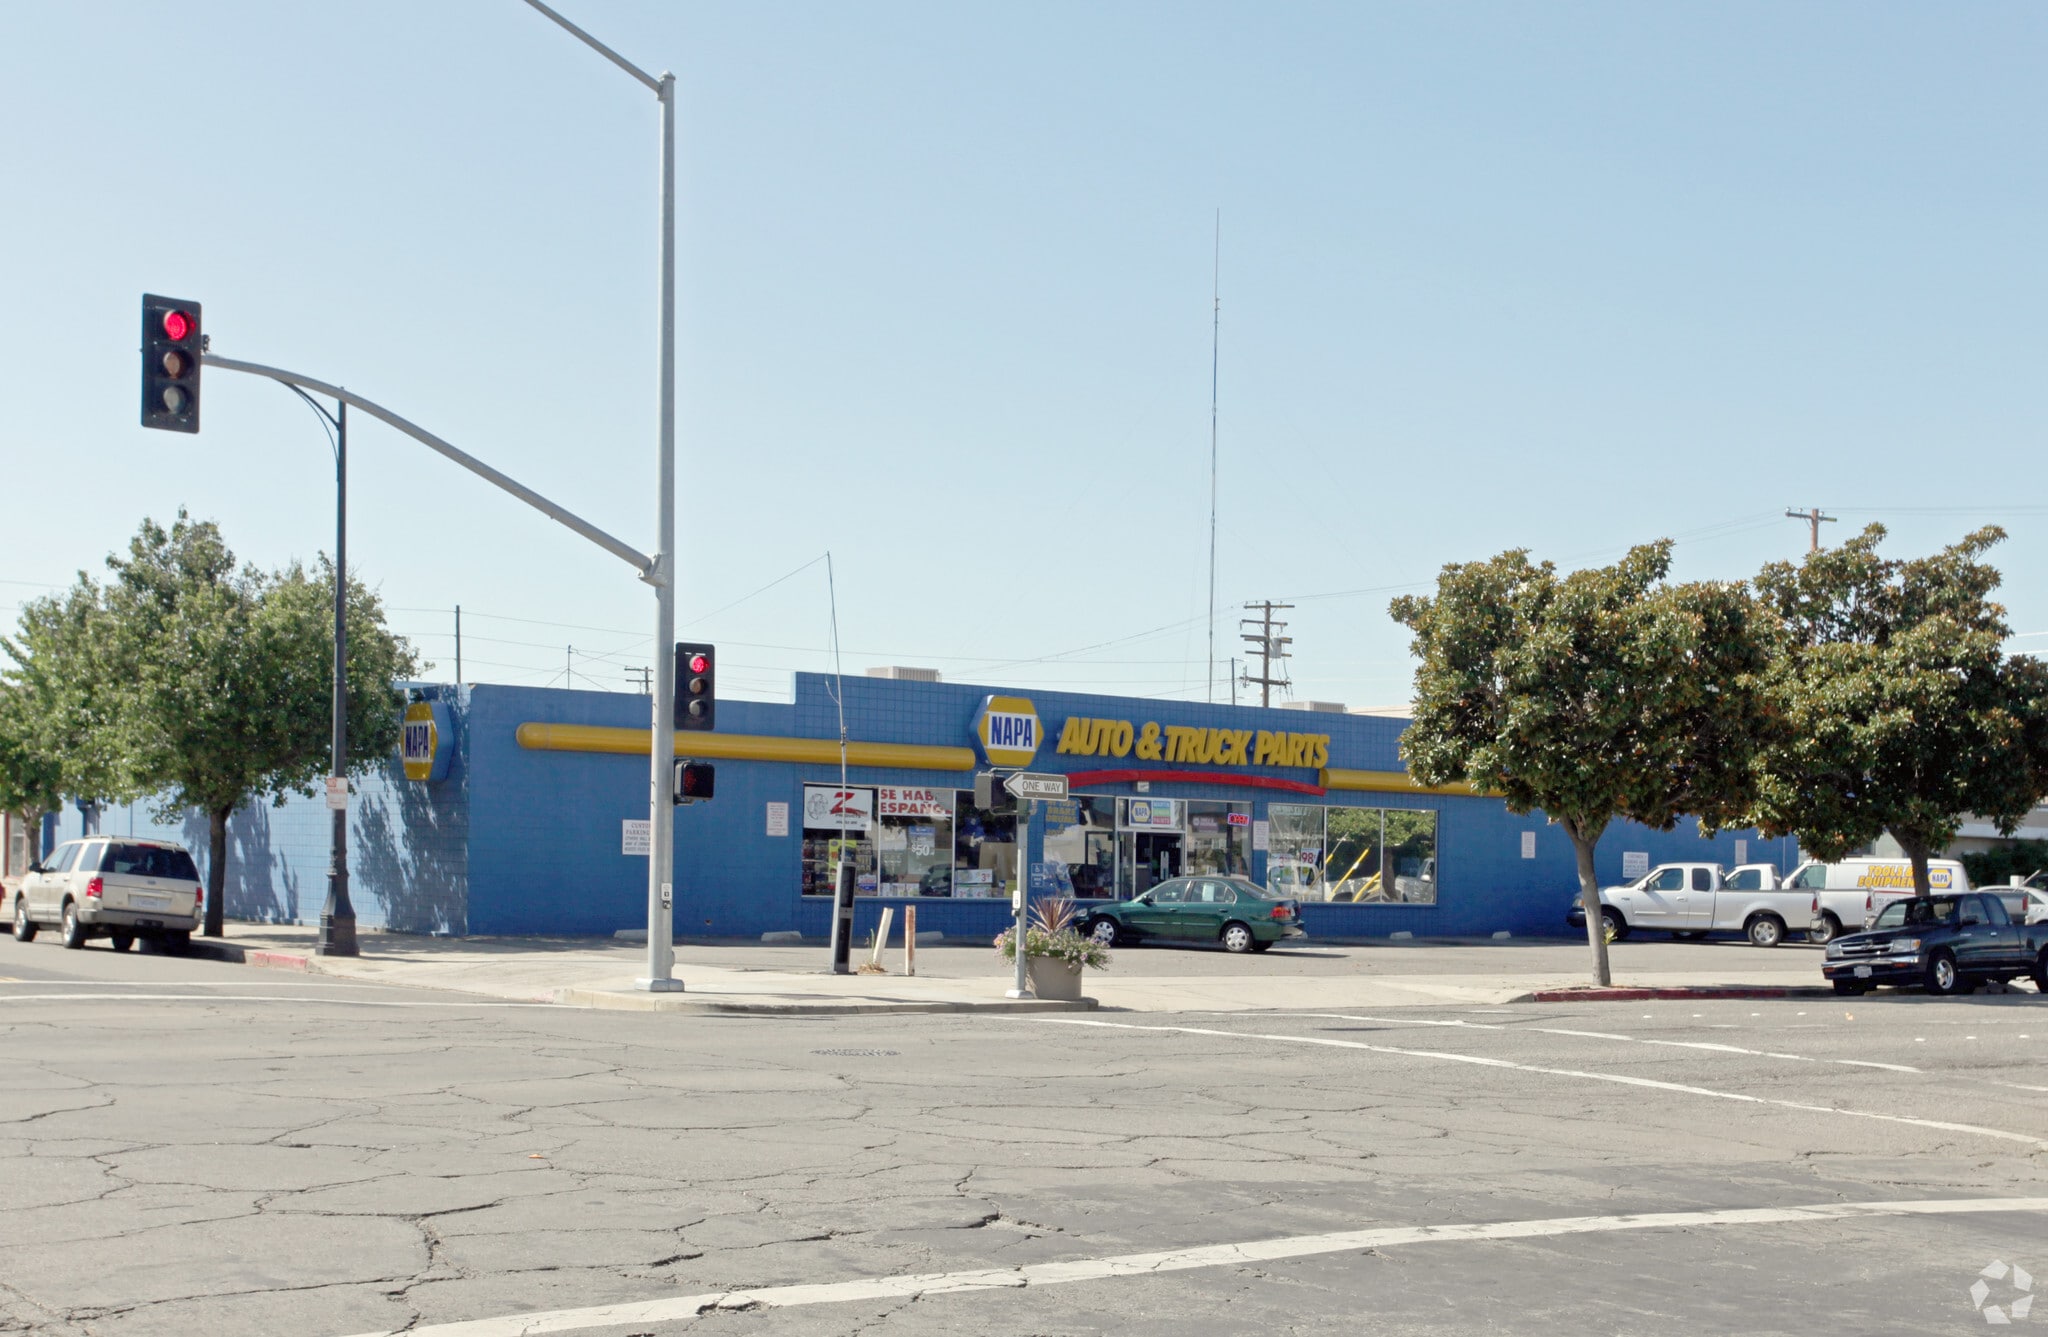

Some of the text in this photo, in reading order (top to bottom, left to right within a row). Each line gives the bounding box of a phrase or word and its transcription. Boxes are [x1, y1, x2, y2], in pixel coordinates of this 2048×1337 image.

[991, 716, 1033, 747] NAPA
[405, 725, 429, 758] NAPA
[1056, 716, 1330, 769] AUTO & TRUCK PARTS
[1022, 780, 1062, 792] ONE WAY
[880, 788, 935, 801] SE HAB
[1868, 865, 1904, 877] TOOLS
[1857, 875, 1916, 888] EQUIPMEN
[1931, 875, 1948, 883] NAPA
